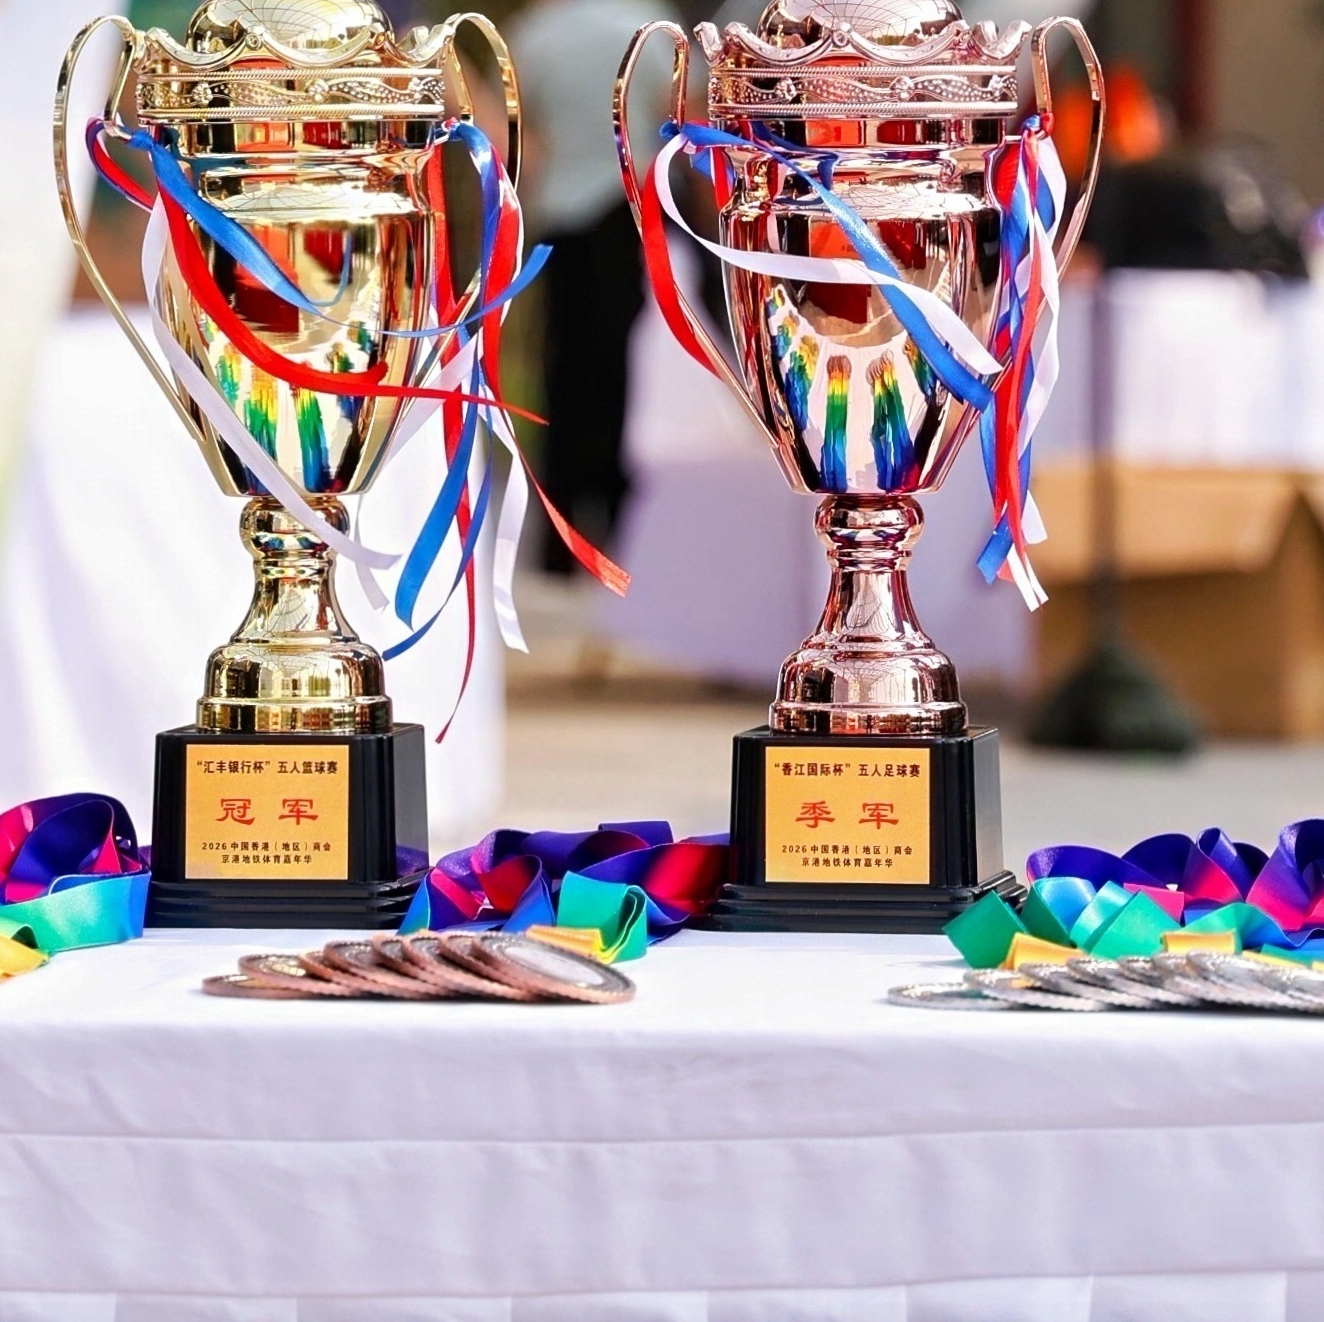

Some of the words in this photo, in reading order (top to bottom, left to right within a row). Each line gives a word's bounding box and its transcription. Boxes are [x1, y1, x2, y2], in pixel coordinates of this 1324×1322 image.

[214, 797, 319, 826] 冠军
[794, 800, 900, 830] 季军
[221, 854, 312, 865] 京港地铁体育嘉年华
[801, 856, 893, 868] 京港地铁体育嘉年华
